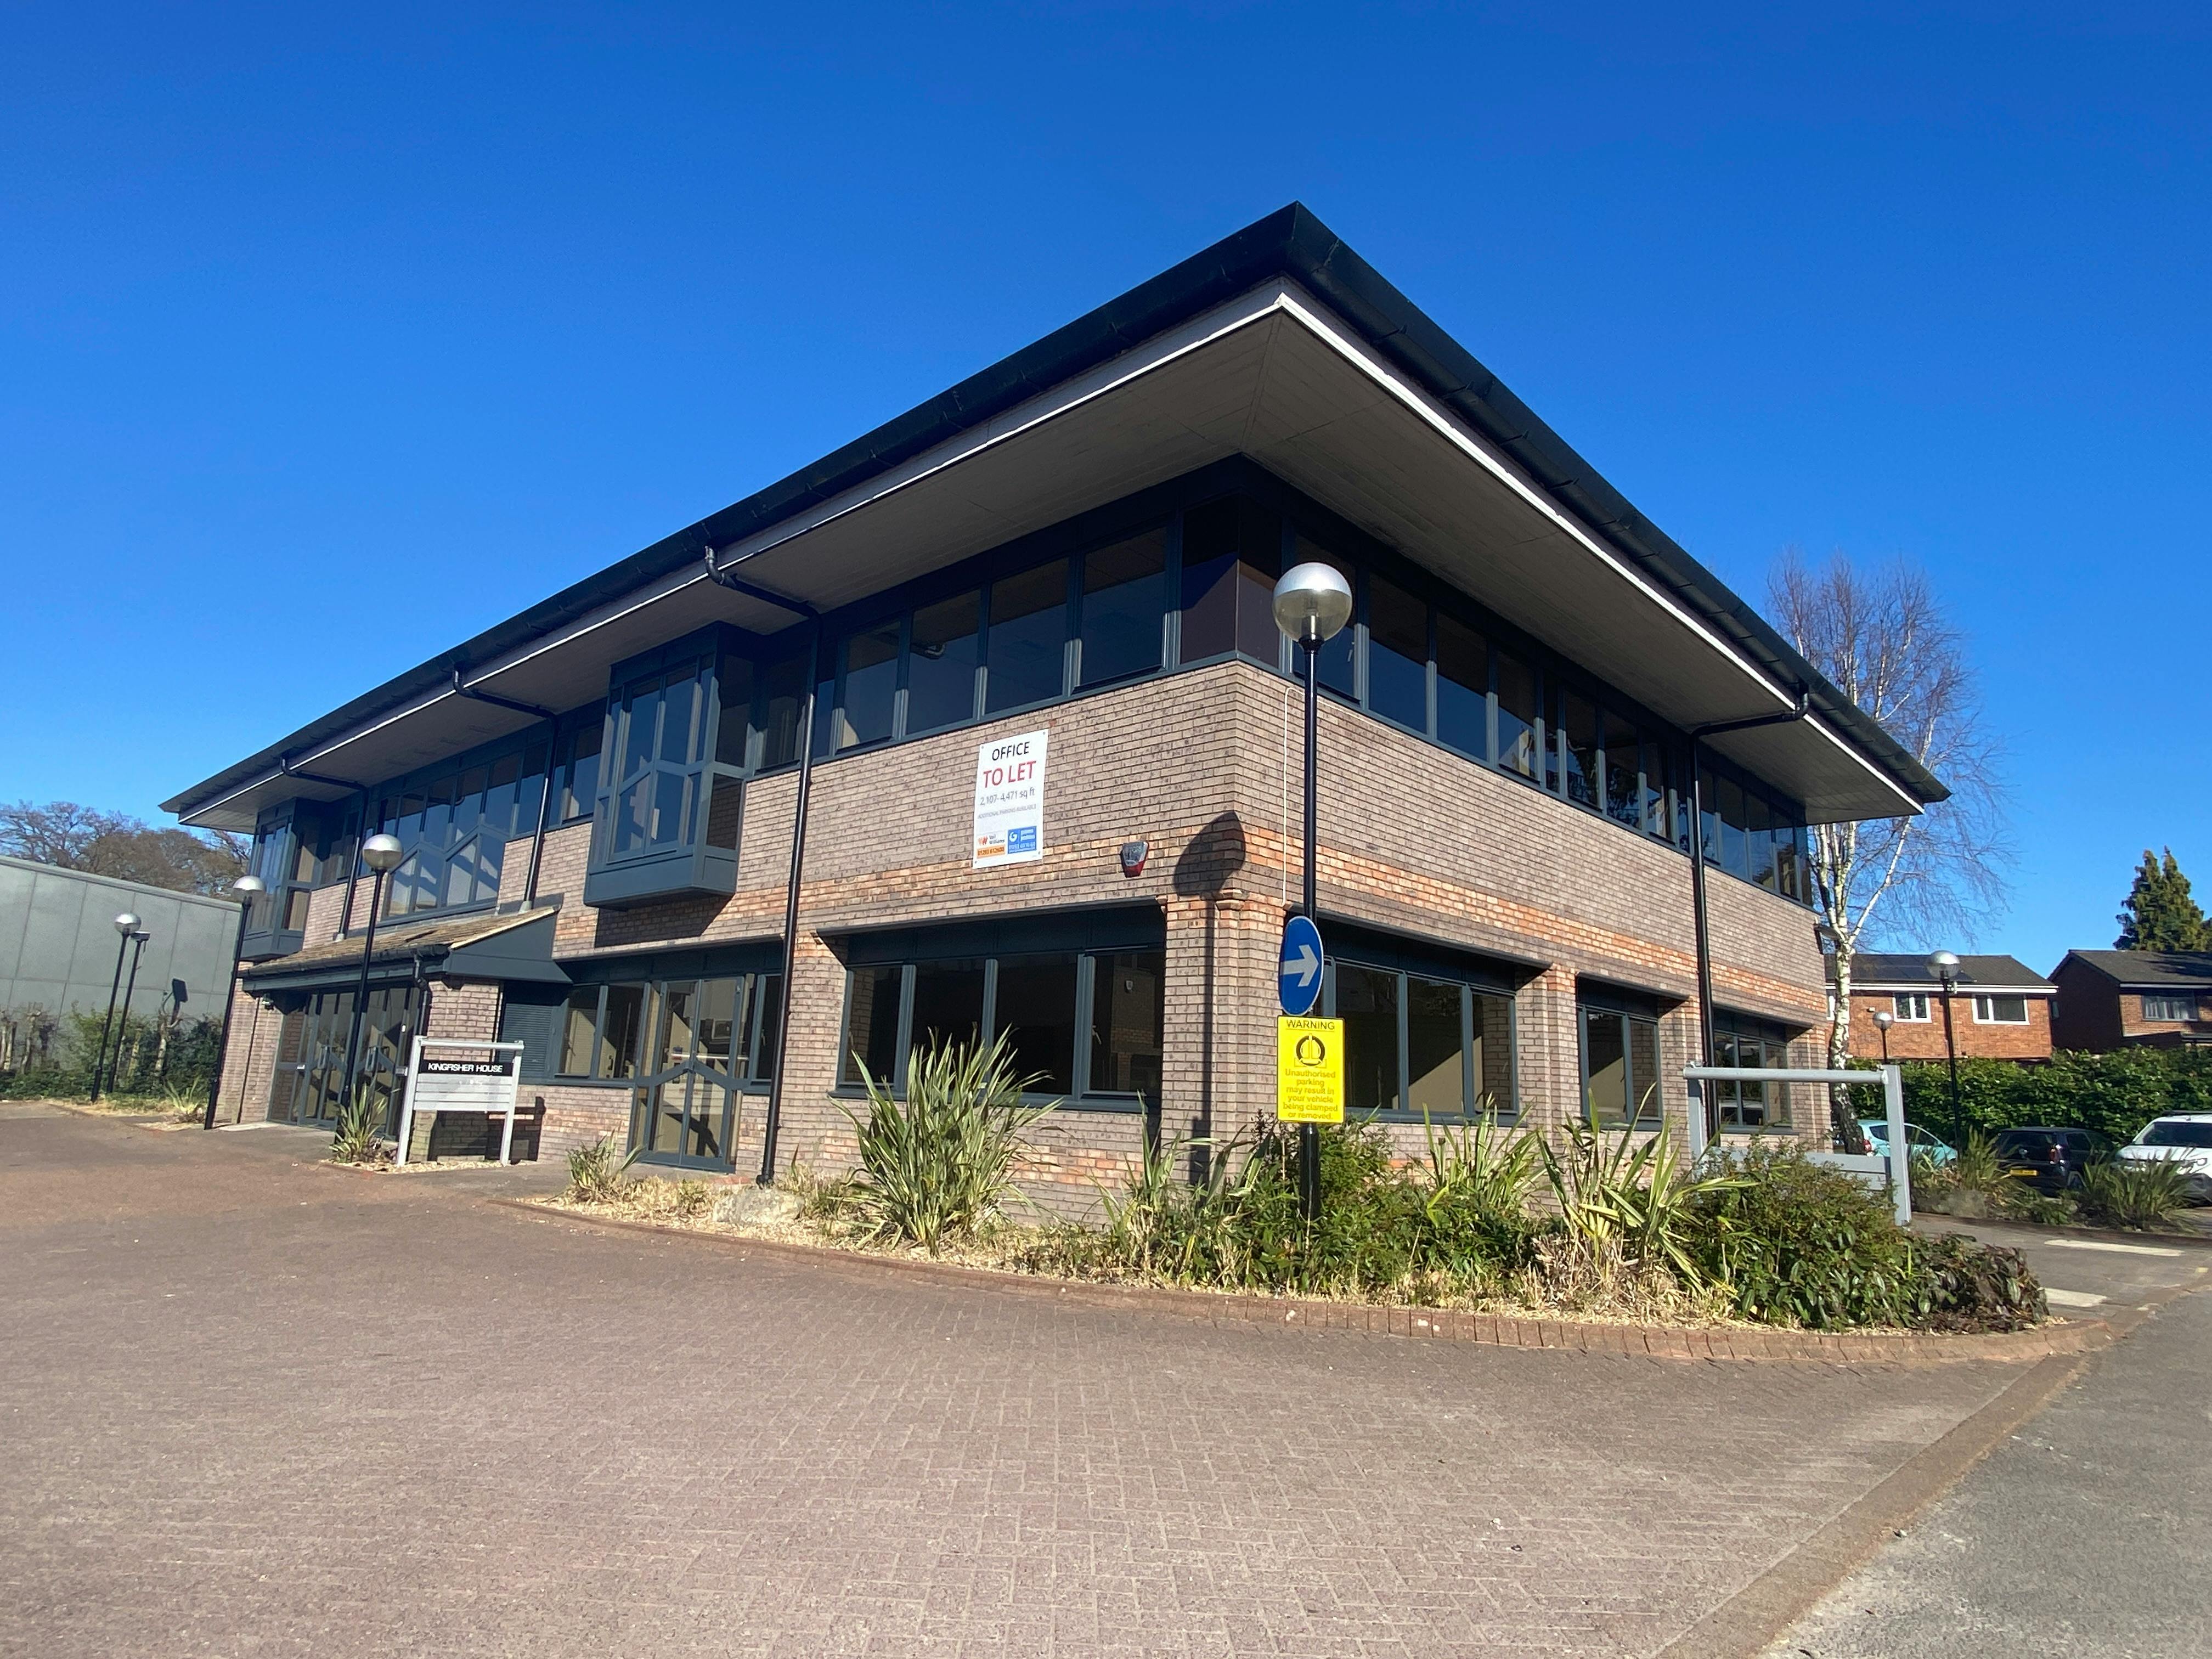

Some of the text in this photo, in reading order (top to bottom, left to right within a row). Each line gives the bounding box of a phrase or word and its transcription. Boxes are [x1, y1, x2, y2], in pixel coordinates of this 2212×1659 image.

[992, 741, 1030, 761] OFFICE
[983, 760, 1036, 788] TO LET
[1020, 790, 1028, 799] sq
[1029, 787, 1035, 796] ft
[1286, 1019, 1335, 1030] WARNING
[475, 1065, 503, 1073] HOUSE
[1285, 1068, 1336, 1078] Unauthorised
[1296, 1079, 1324, 1087] parking
[1283, 1102, 1338, 1112] being clamped
